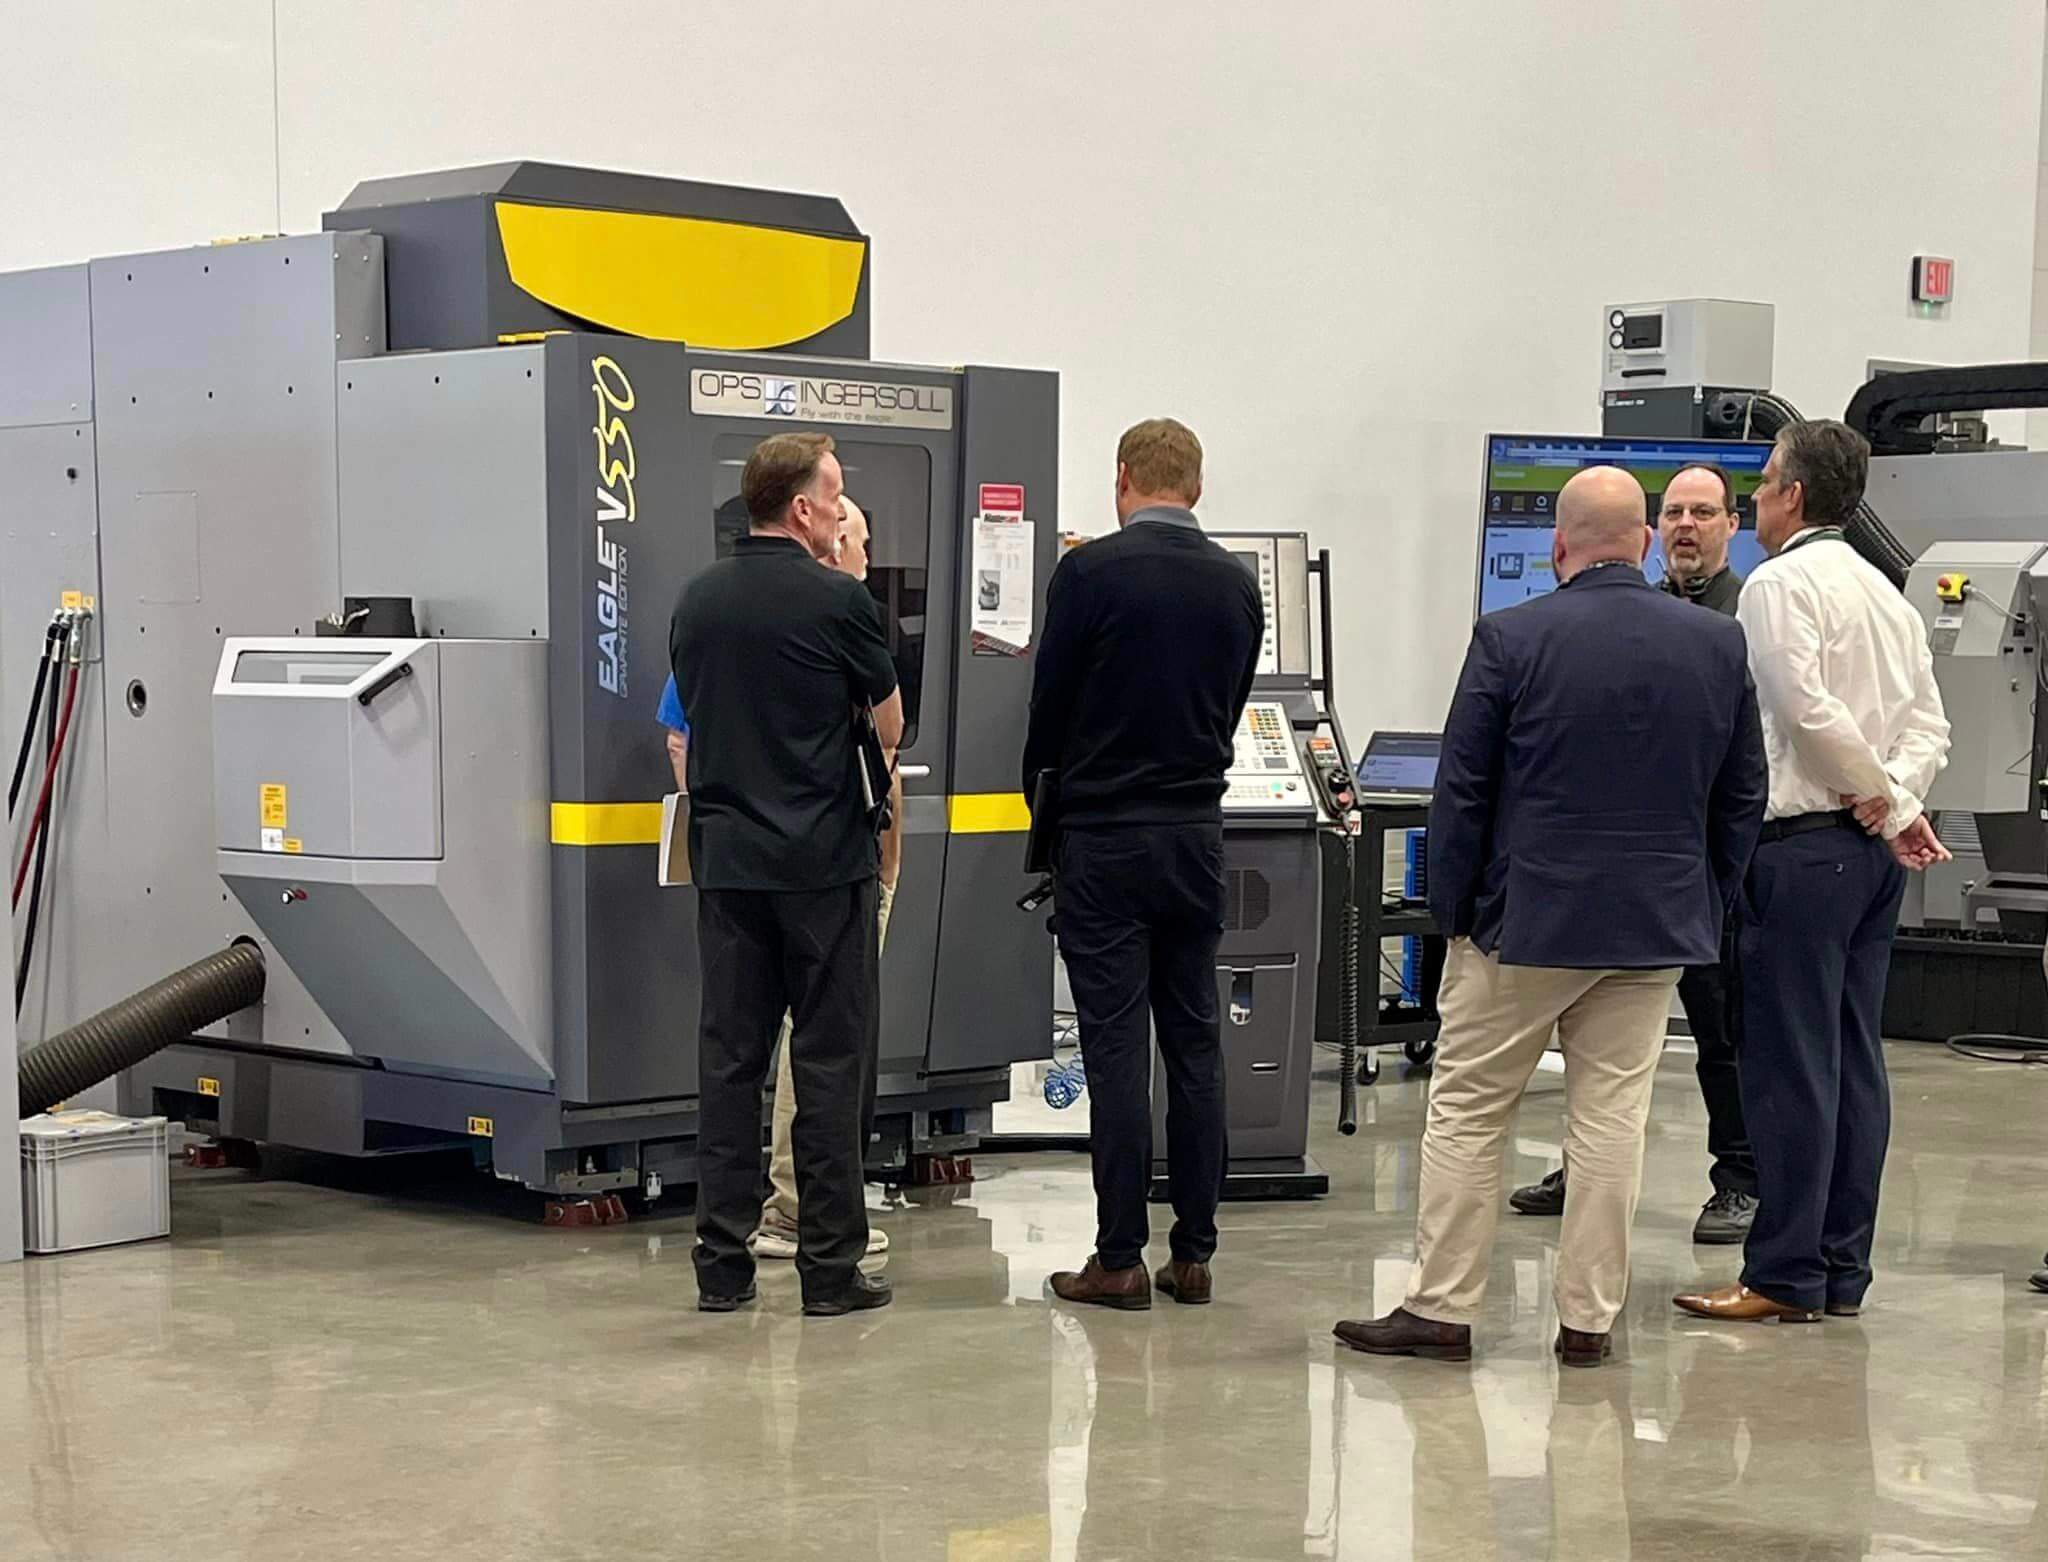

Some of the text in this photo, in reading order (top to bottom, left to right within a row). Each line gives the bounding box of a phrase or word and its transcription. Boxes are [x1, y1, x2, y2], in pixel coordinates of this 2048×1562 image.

[699, 373, 945, 413] OPS INGERSOLL
[597, 525, 618, 694] EAGLE
[618, 544, 629, 699] GRAPHITE EDITION
